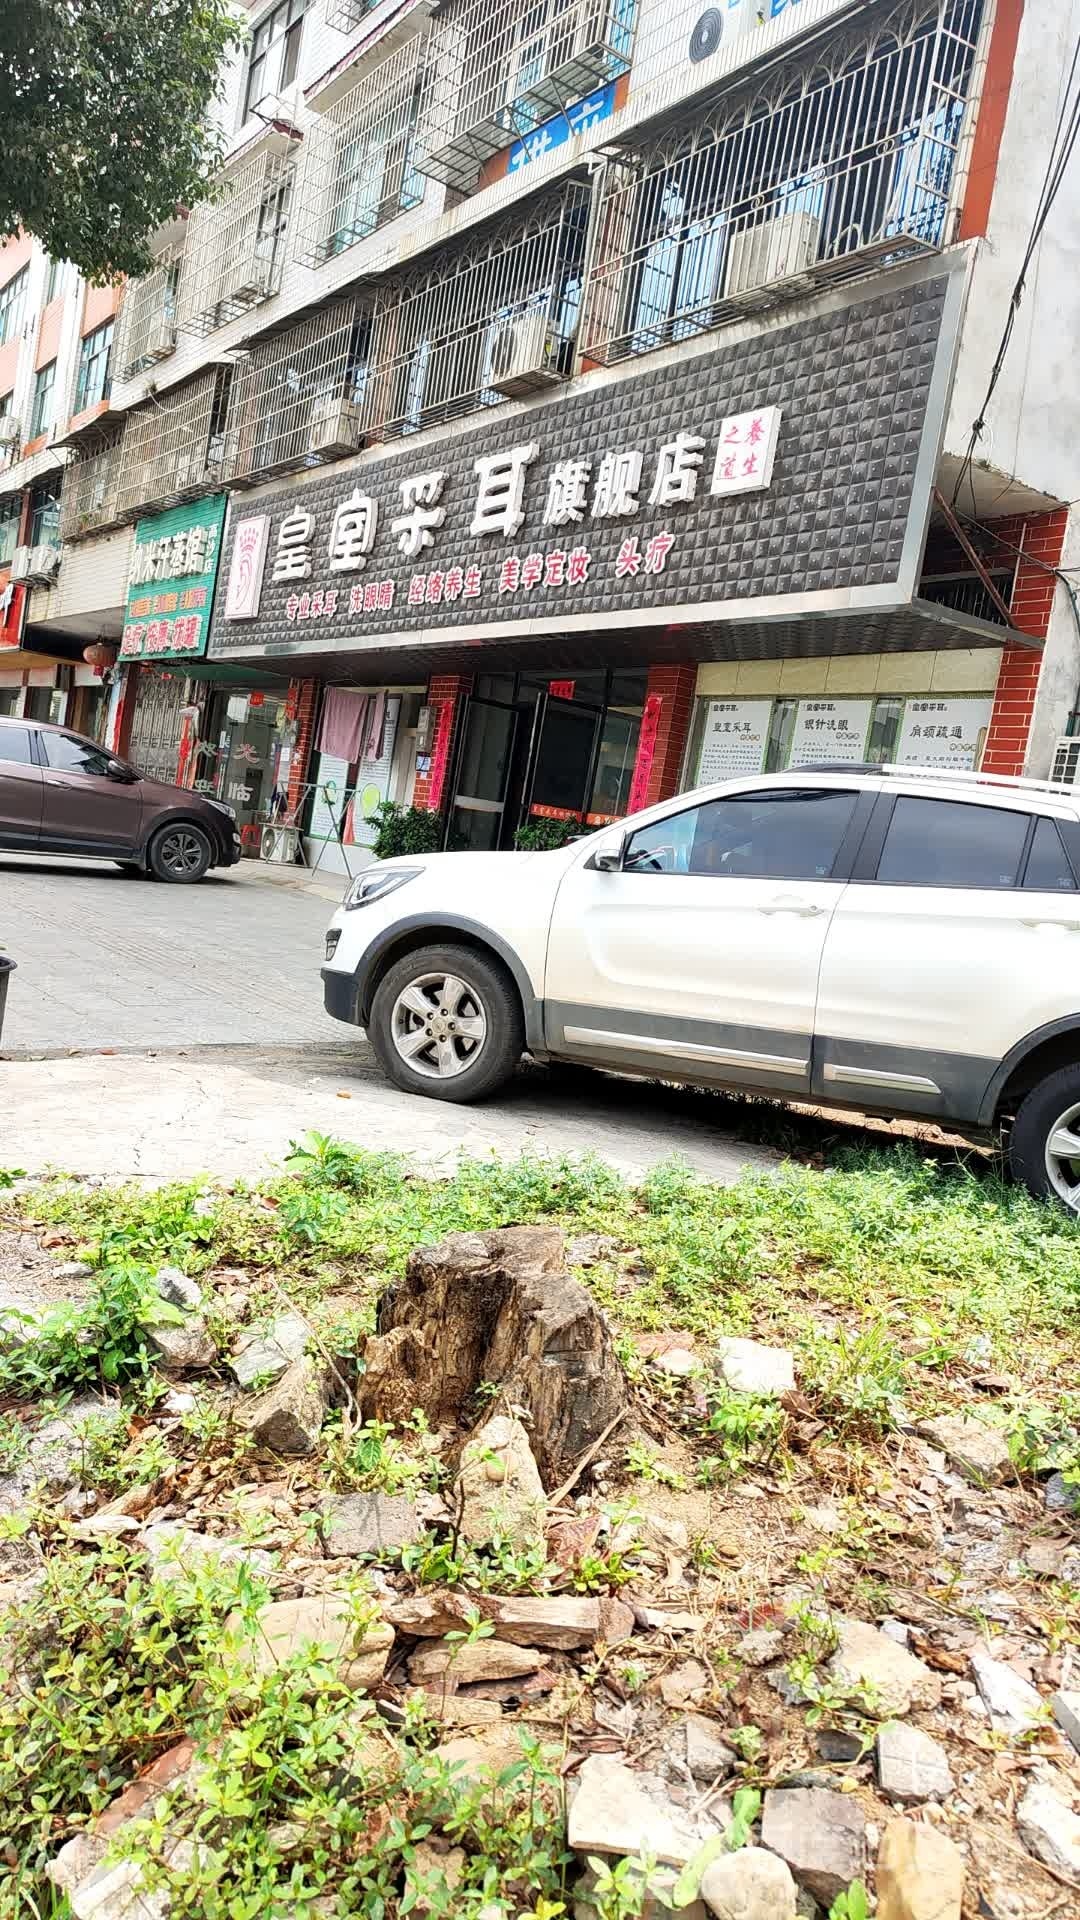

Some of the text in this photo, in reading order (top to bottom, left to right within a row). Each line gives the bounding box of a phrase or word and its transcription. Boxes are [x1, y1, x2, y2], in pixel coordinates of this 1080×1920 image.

[271, 432, 706, 583] 皇室采耳旗舰店
[285, 531, 676, 620] 专业采耳 洗眼睛 经络养生 美学定妆 头疗
[909, 724, 963, 739] 肩颈疏通
